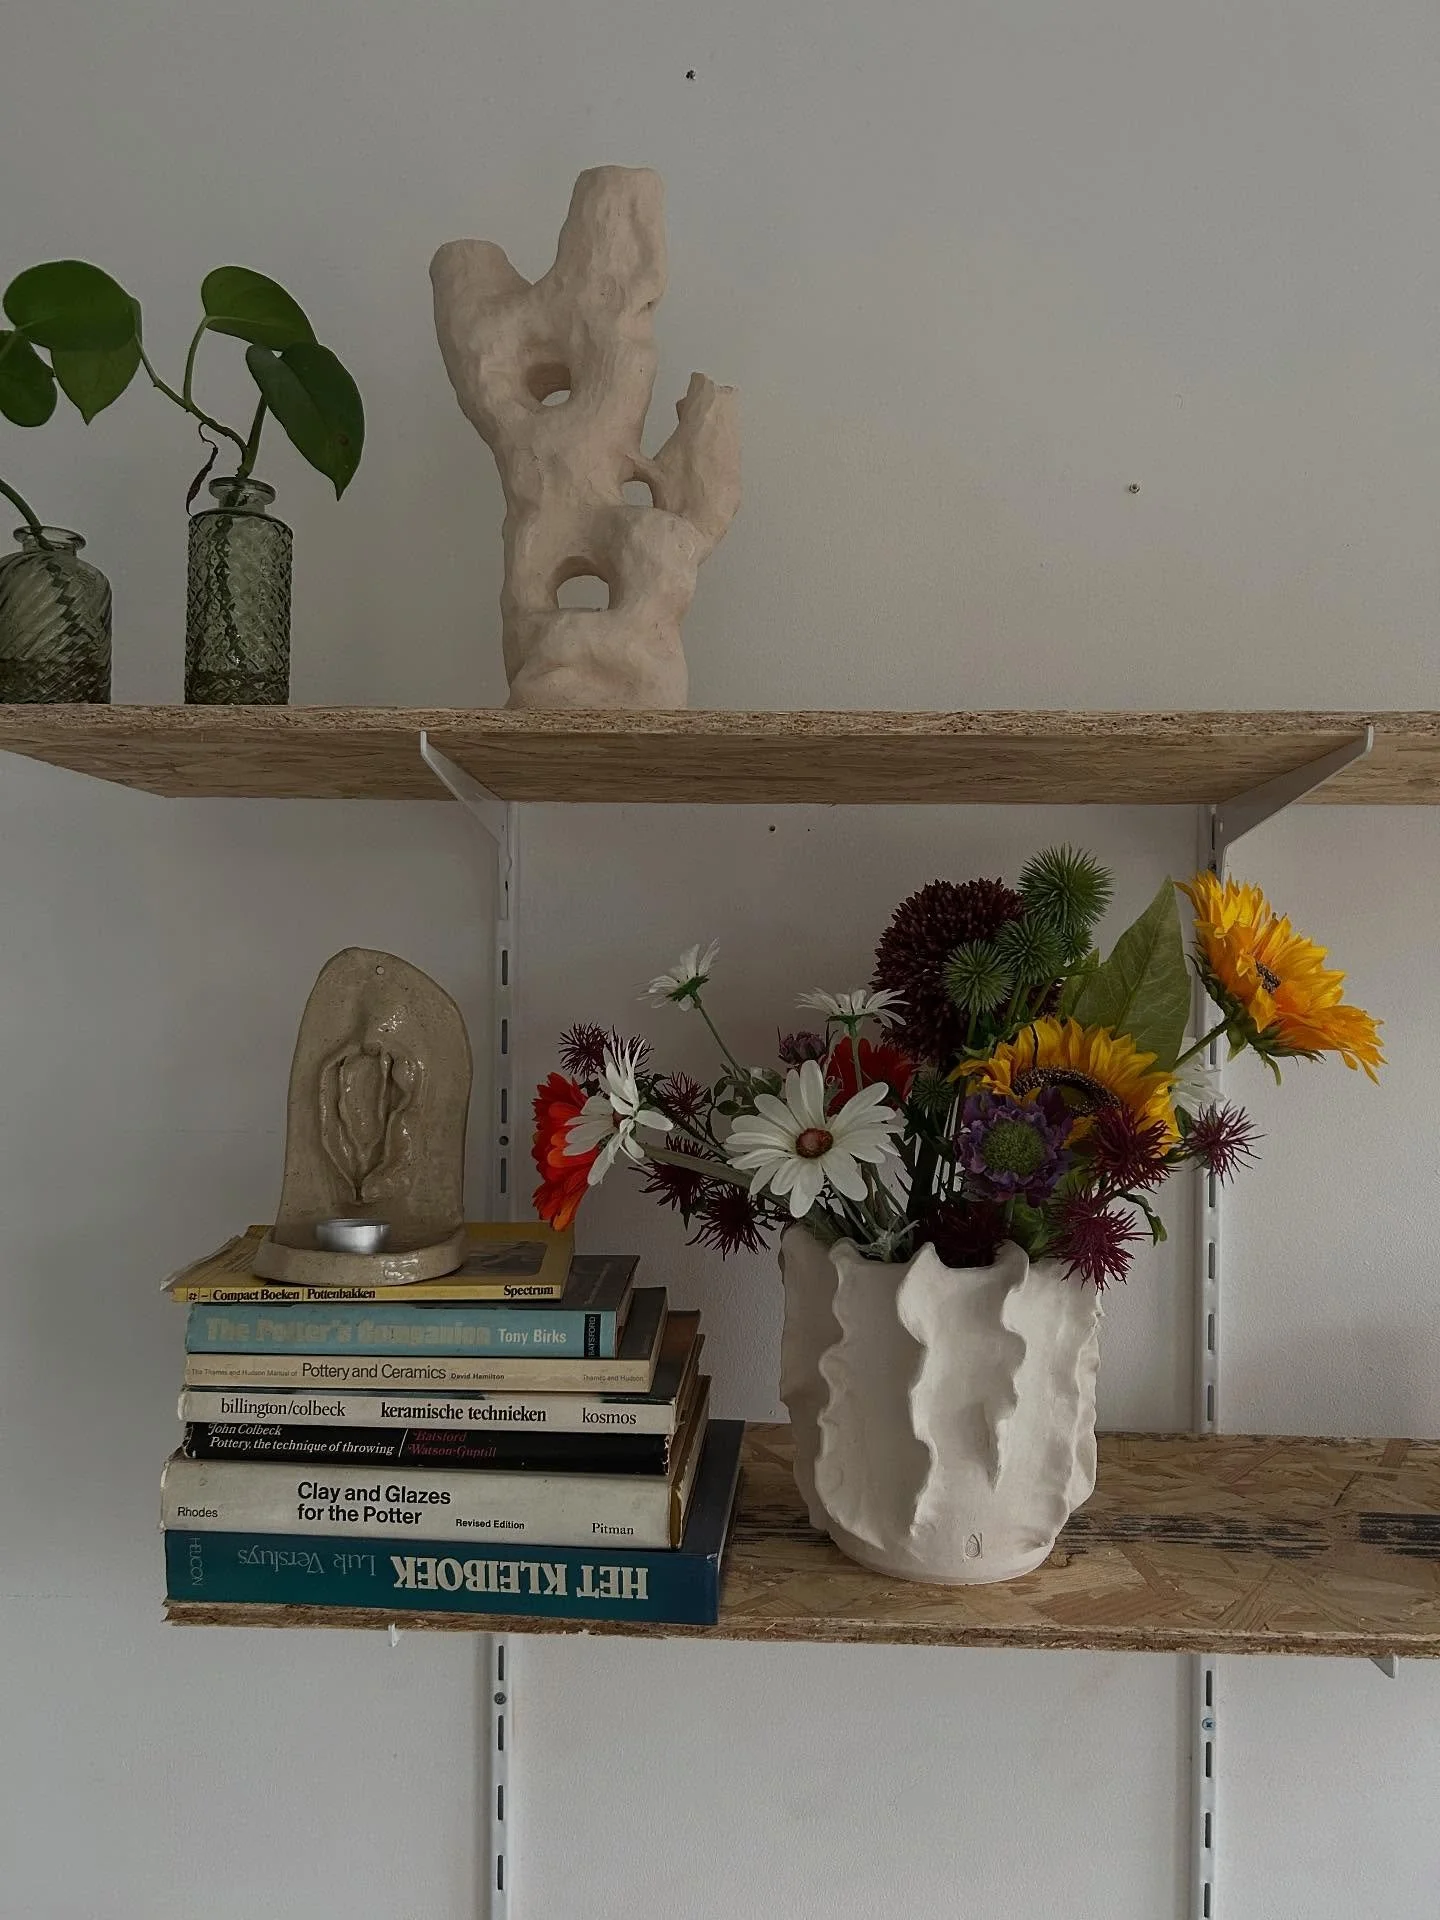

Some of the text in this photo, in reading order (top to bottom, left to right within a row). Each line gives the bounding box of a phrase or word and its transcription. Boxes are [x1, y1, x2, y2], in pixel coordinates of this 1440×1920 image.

[213, 1289, 300, 1302] Compact Boeken
[307, 1289, 376, 1301] Pottenbakken
[503, 1284, 554, 1298] Spectrum
[207, 1318, 251, 1342] The
[256, 1318, 353, 1343] Potter's
[499, 1329, 567, 1345] Tony Birks
[587, 1316, 596, 1357] BATSFORD
[302, 1362, 447, 1381] Pottery and Ceramics
[451, 1372, 471, 1380] David
[221, 1397, 346, 1418] billington/colbeck
[380, 1401, 547, 1422] keramische technieken
[582, 1408, 637, 1425] kosmos
[208, 1423, 283, 1436] John Colbeck
[253, 1437, 270, 1449] the
[271, 1439, 327, 1452] technique
[329, 1440, 342, 1452] of
[343, 1442, 395, 1456] throwing
[297, 1481, 451, 1505] Clay and Glazes
[177, 1506, 218, 1518] Rhodes
[297, 1503, 422, 1524] for the Potter
[455, 1518, 525, 1530] Revised Edition
[591, 1522, 634, 1535] Pitman
[189, 1537, 204, 1586] HELICON
[238, 1544, 376, 1576] Luk Versluys
[390, 1555, 649, 1600] HET KLEIBOEK
